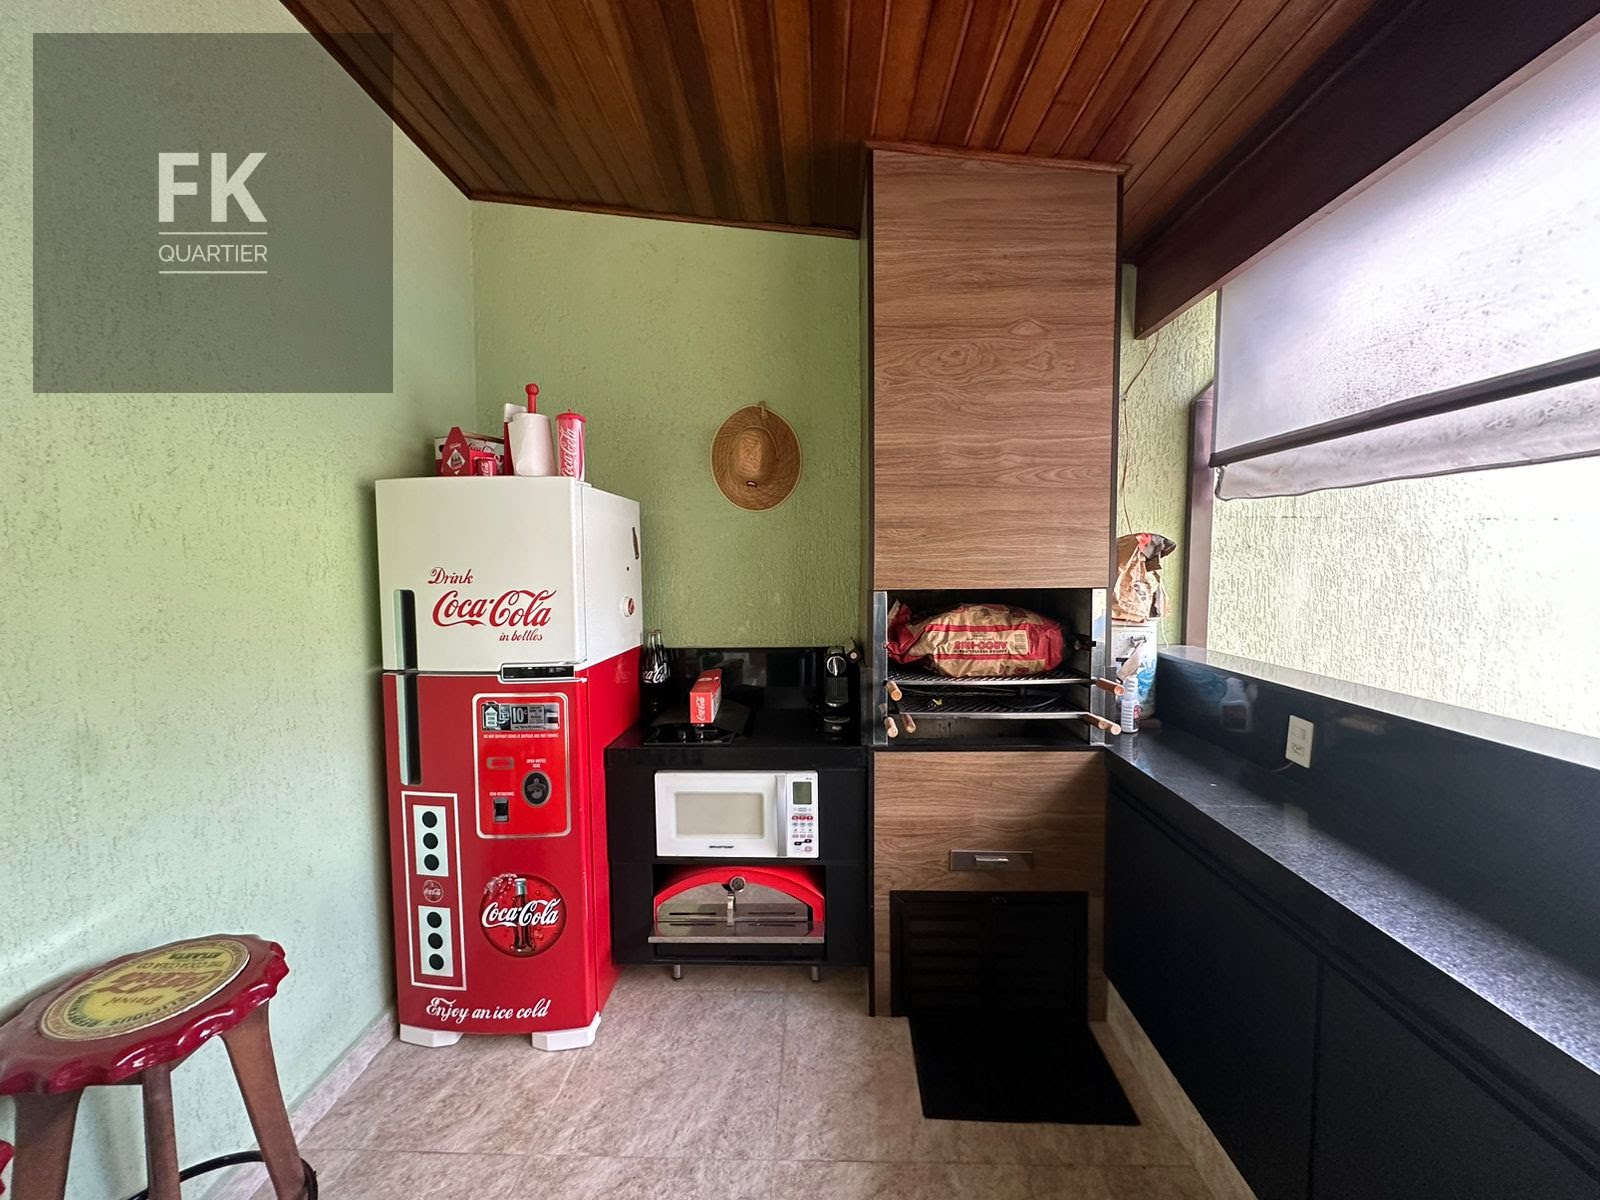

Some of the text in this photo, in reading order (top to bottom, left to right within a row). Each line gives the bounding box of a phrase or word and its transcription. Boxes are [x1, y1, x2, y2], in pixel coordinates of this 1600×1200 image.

[428, 566, 473, 585] Drink
[432, 589, 557, 628] Coca-Cola
[499, 628, 543, 642] in bottles
[482, 898, 561, 928] Coca-Cola
[426, 997, 551, 1024] Enjoy an ice cold
